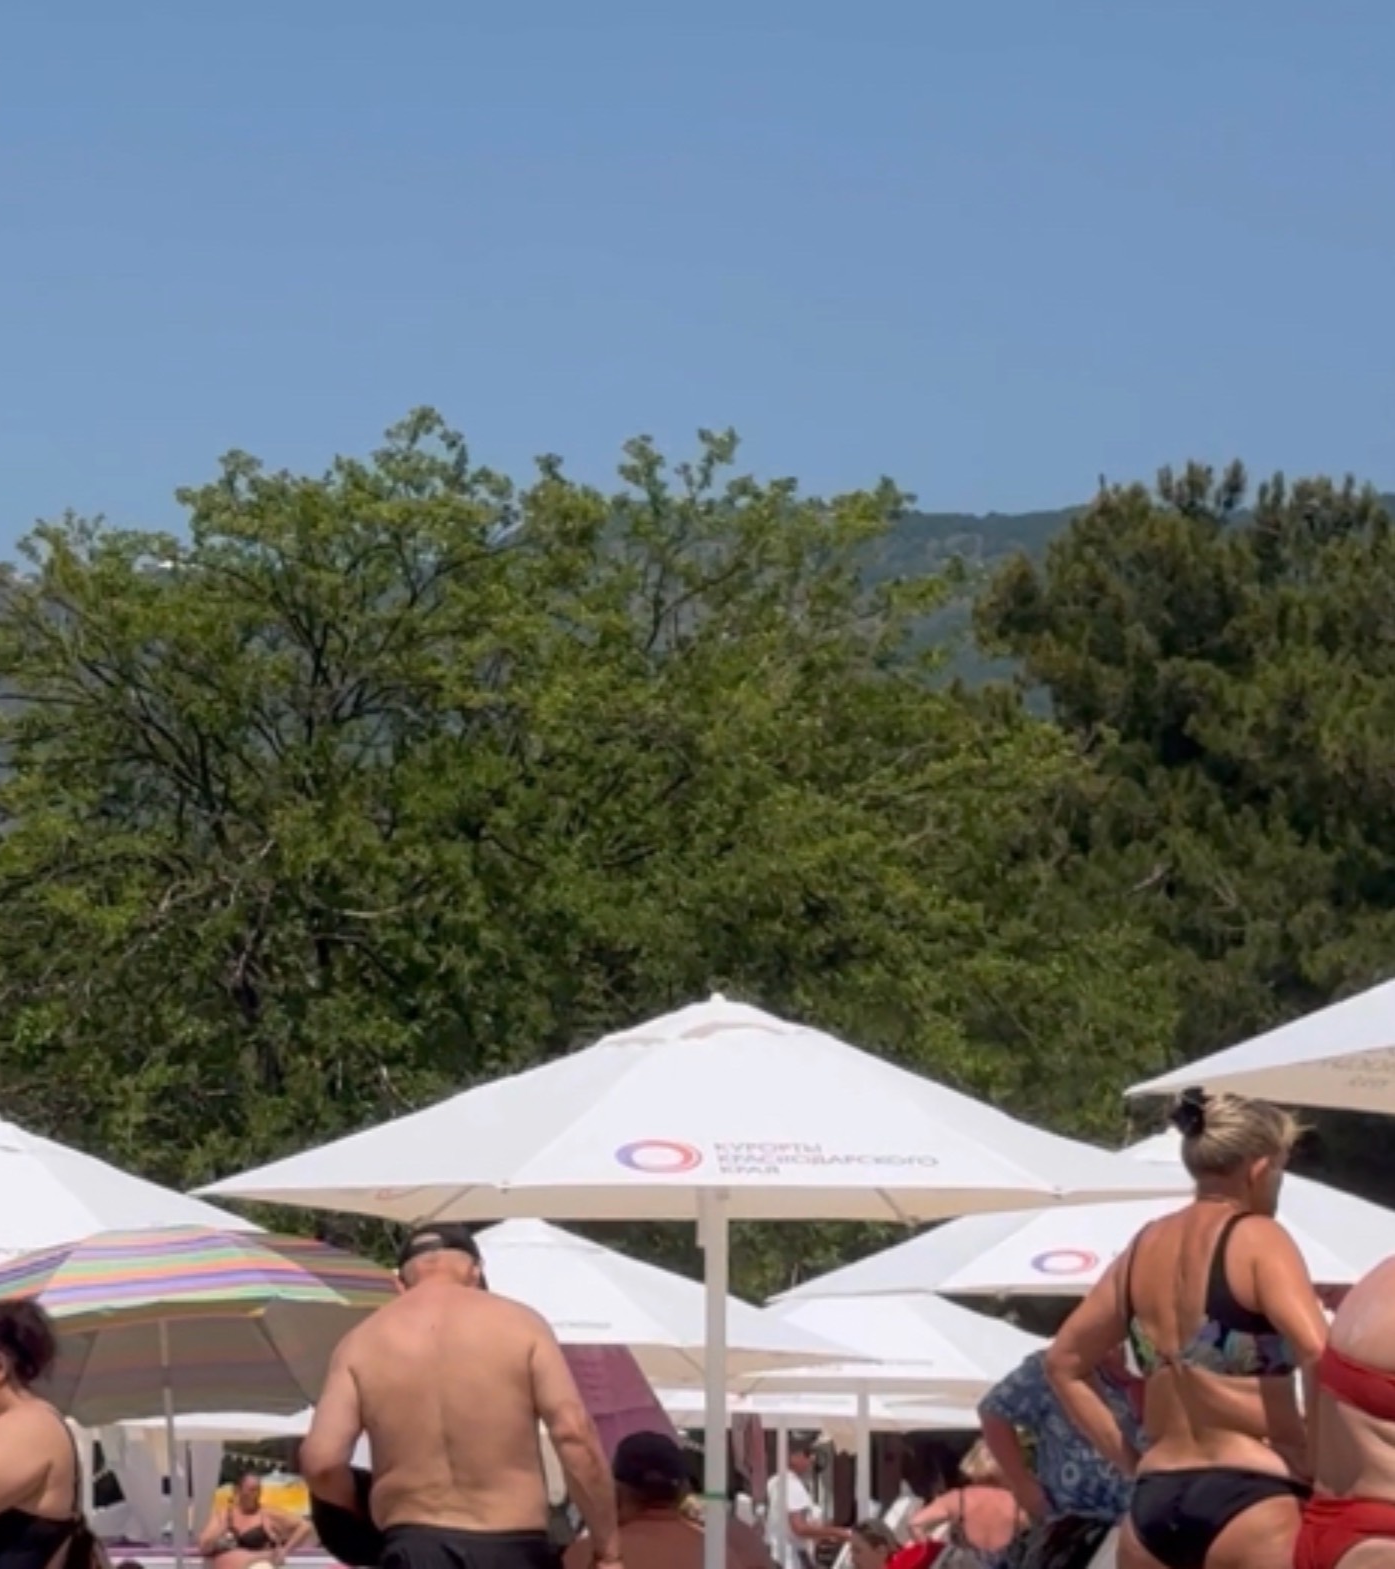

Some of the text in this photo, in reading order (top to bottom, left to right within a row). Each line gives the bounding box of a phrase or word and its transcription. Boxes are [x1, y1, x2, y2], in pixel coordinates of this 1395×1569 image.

[714, 1142, 822, 1153] КУРОРТЫ
[717, 1154, 939, 1167] КРАСНОДАРСКОГО
[719, 1166, 780, 1175] КРАЯ
